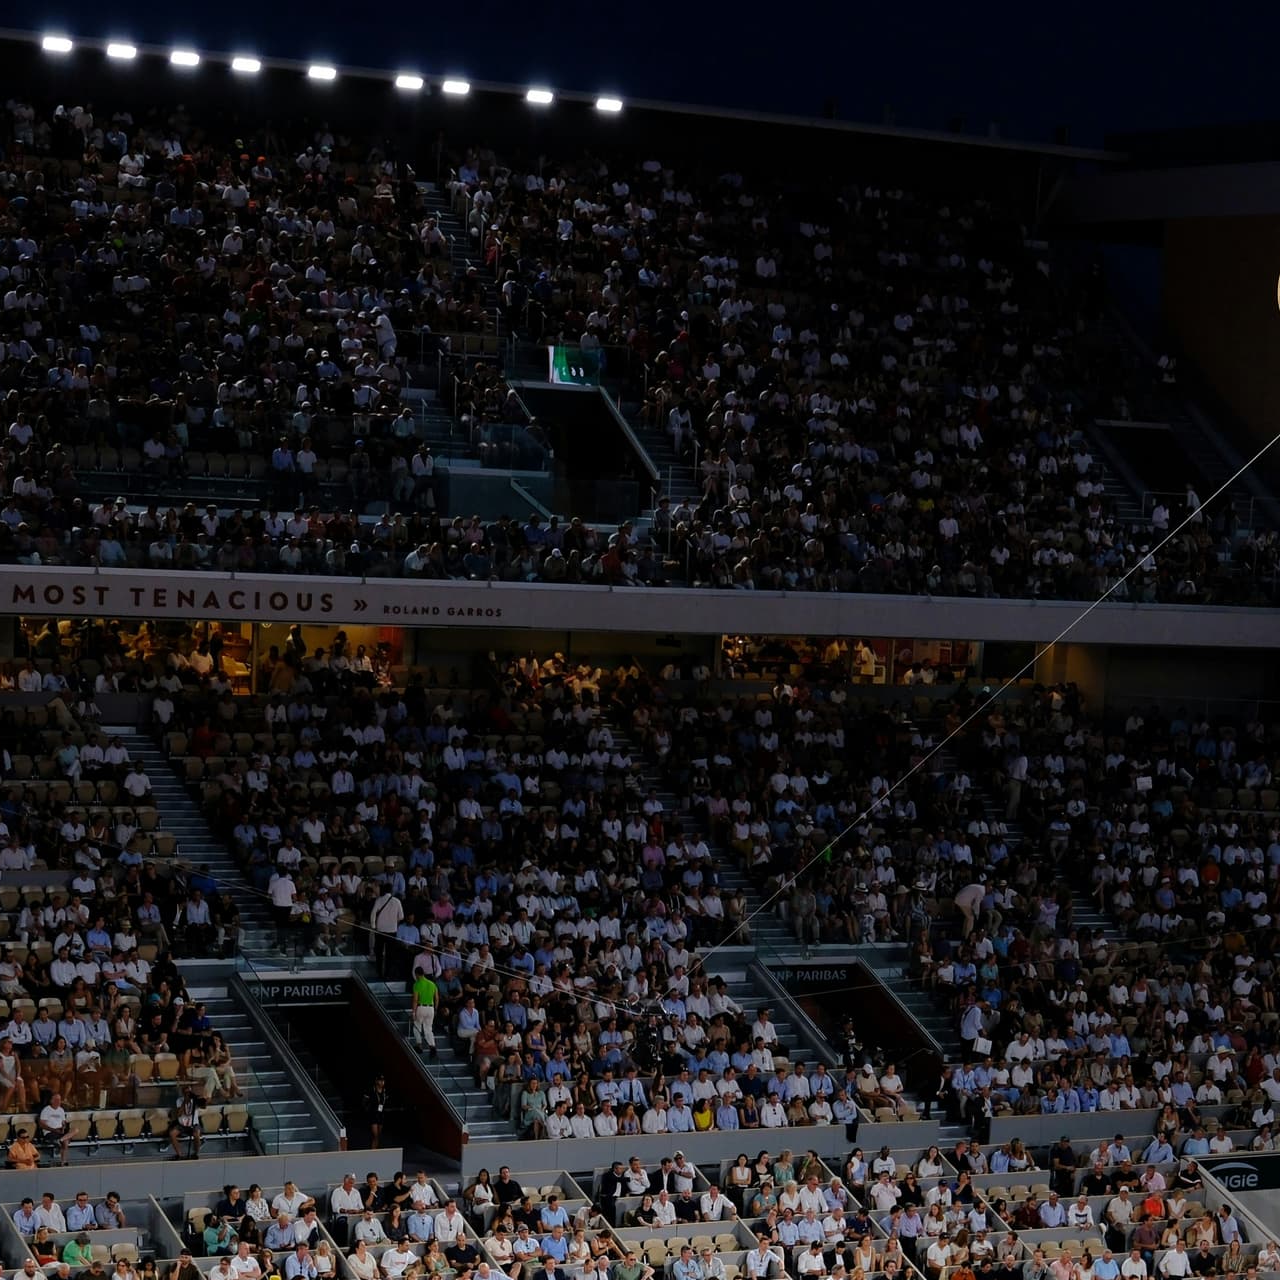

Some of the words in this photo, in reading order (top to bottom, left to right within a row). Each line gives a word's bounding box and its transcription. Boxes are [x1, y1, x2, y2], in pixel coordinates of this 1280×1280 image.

[12, 584, 110, 606] MOST
[129, 587, 334, 613] TENACIOUS
[382, 604, 441, 616] ROLAND
[446, 606, 503, 617] GARROS
[796, 969, 847, 981] PARIBAS
[283, 984, 343, 997] PARIBAS
